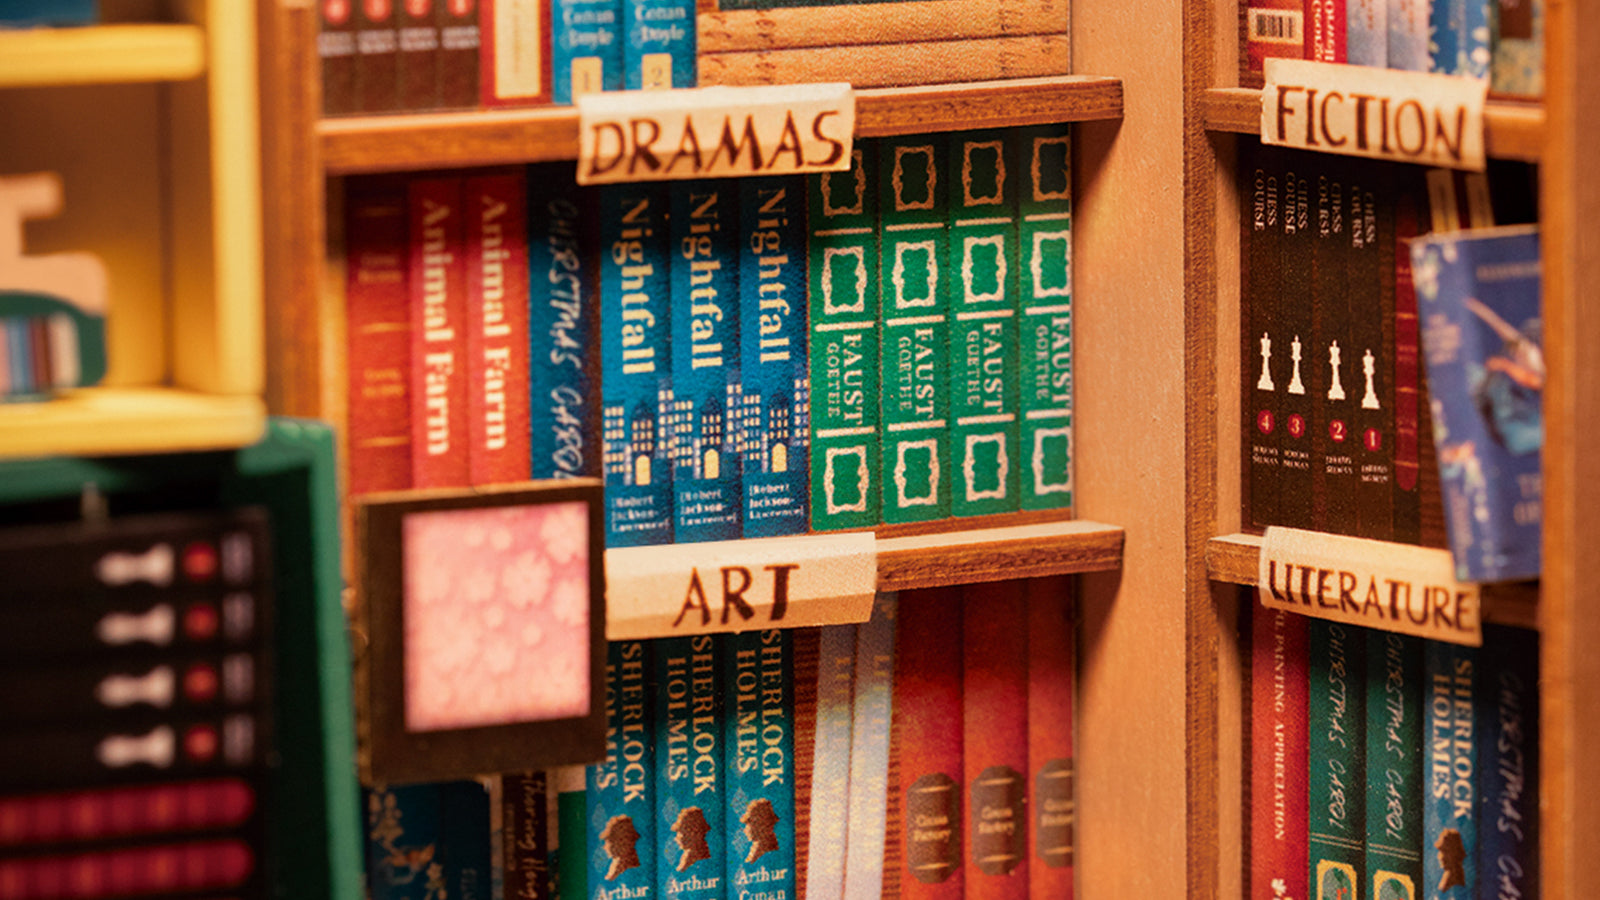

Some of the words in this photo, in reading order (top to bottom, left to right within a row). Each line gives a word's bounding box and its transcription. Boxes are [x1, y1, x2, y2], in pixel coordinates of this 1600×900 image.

[589, 110, 844, 177] DRAMAS
[1276, 85, 1466, 162] FICTION
[1267, 176, 1278, 226] CHESS
[1297, 179, 1308, 230] CHESS
[1332, 182, 1342, 233] CHESS
[1364, 192, 1376, 243] CHESS
[423, 199, 455, 342] Animal
[482, 196, 511, 336] Animal
[612, 198, 655, 375] Nightfall
[682, 192, 724, 370] Nightfall
[751, 187, 791, 364] Nightfall
[425, 353, 455, 455] Farm
[484, 347, 511, 450] Farm
[843, 334, 864, 425] FAUST
[915, 328, 934, 420] FAUST
[983, 322, 1003, 412] FAUST
[1261, 415, 1269, 431] 4
[1291, 418, 1300, 434] 3
[1333, 422, 1343, 439] 2
[1370, 431, 1376, 447] 1
[672, 564, 800, 628] ART
[1269, 560, 1475, 632] LITERATURE
[692, 636, 715, 796] SHERLOCK
[736, 650, 758, 773] HOLMES
[761, 629, 784, 787] SHERLOCK
[1274, 634, 1285, 713] PAINTING
[621, 643, 645, 803] SHERLOCK
[667, 658, 688, 781] HOLMES
[1432, 674, 1451, 800] HOLMES
[1454, 658, 1473, 819] SHERLOCK
[1274, 720, 1285, 840] APPRECIATION
[1329, 759, 1346, 829] CAROL
[1385, 768, 1403, 840] CAROL
[668, 875, 720, 893] Arthur
[738, 866, 788, 884] Arthur
